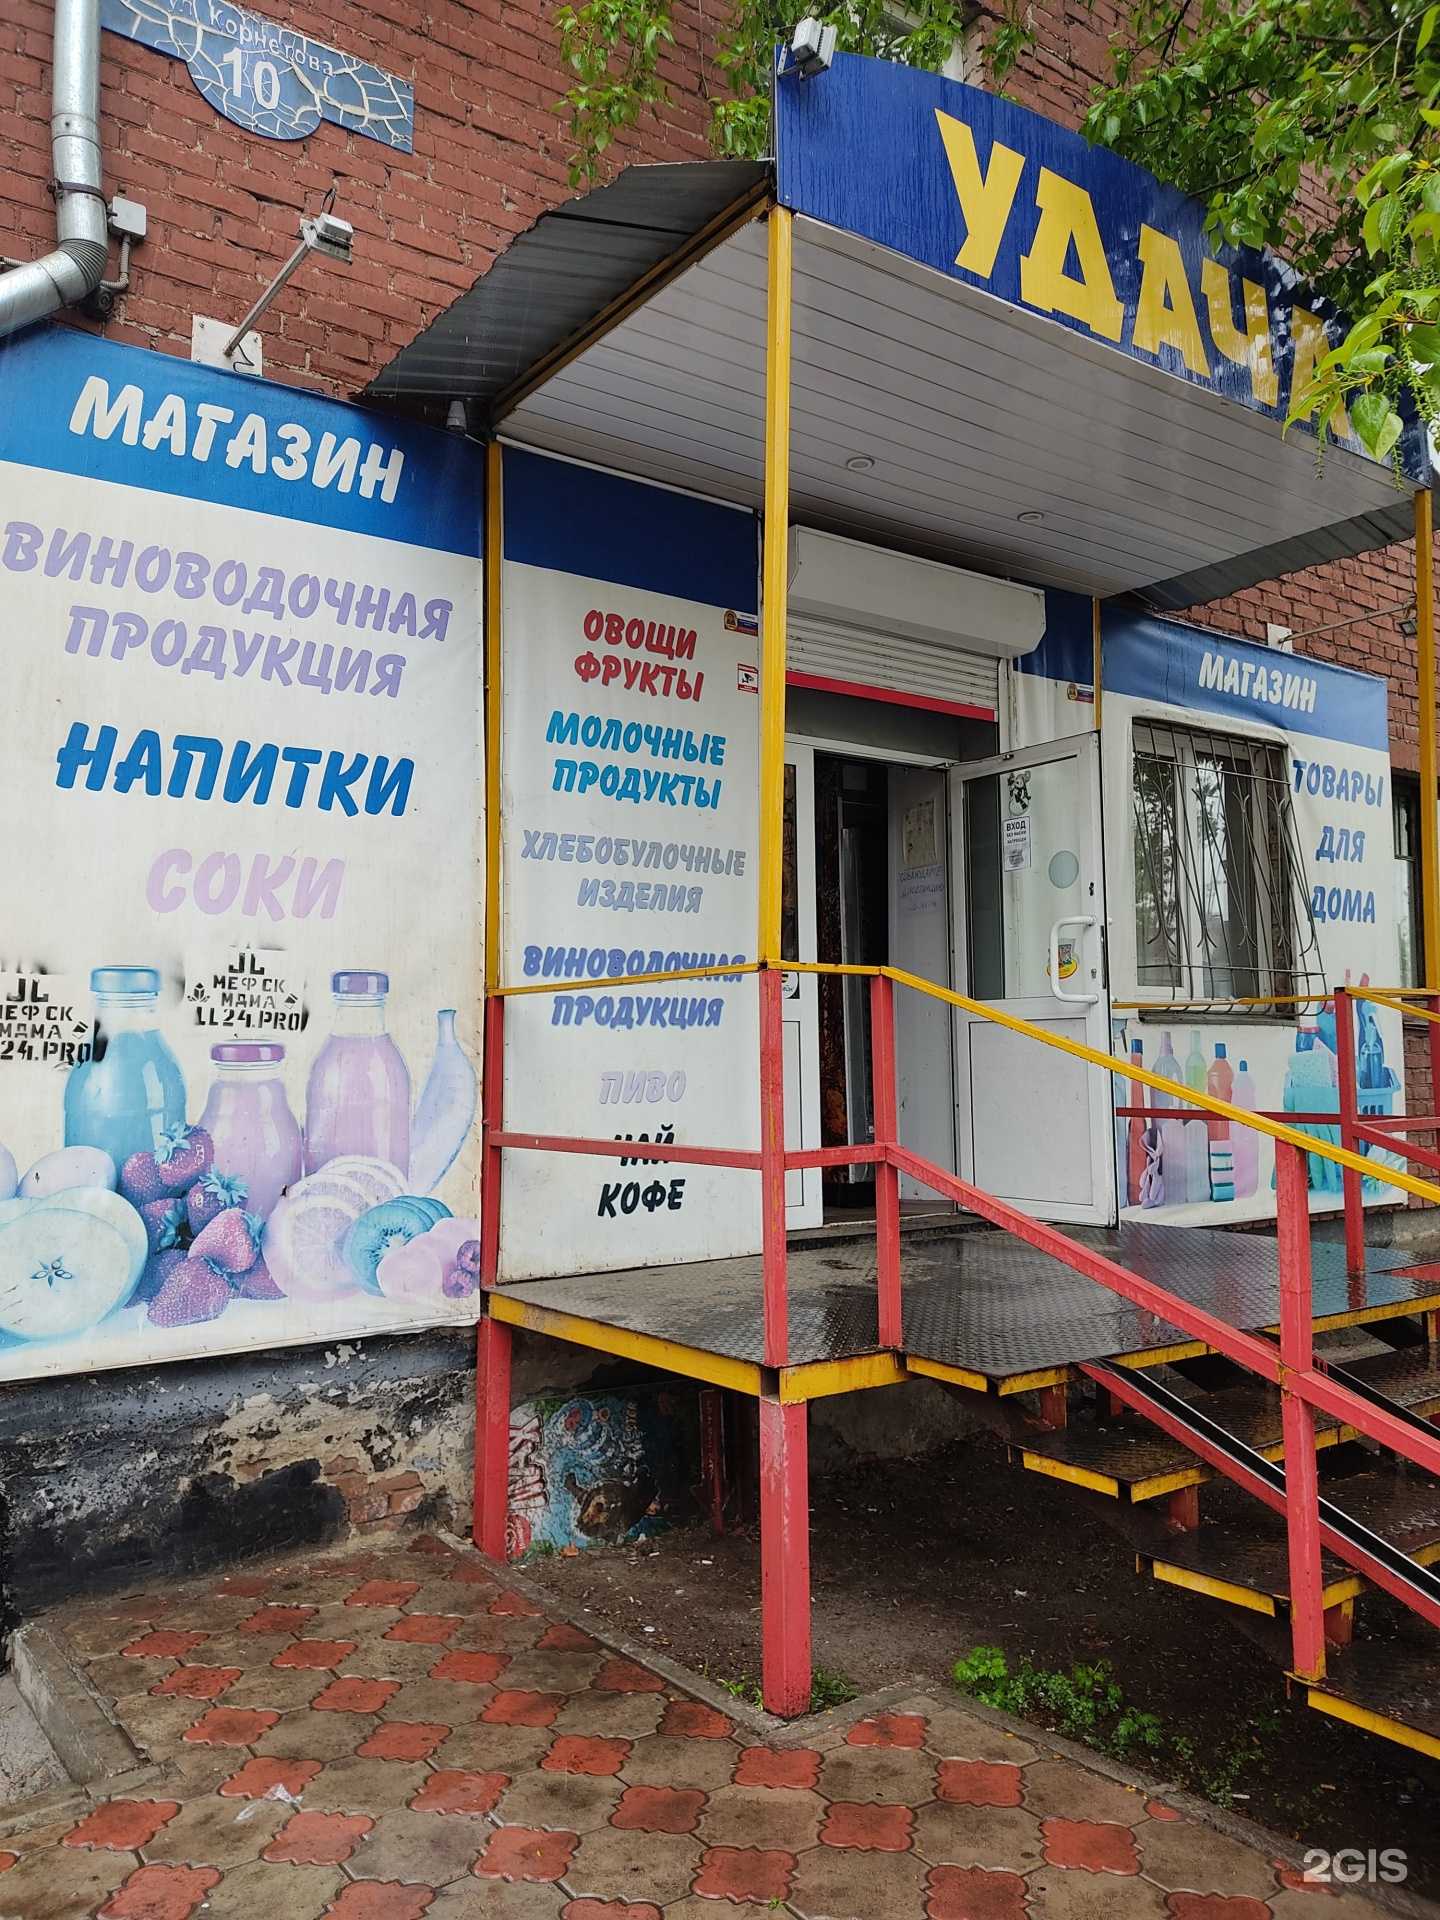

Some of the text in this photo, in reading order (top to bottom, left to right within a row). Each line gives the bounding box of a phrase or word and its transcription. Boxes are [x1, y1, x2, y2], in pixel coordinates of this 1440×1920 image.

[223, 47, 281, 110] 10
[933, 107, 1351, 441] УДАЧА
[69, 375, 405, 504] МАГАЗИН
[1, 521, 454, 642] ВИНОВОДОЧНАЯ
[64, 605, 407, 698] ПРОДУКЦИЯ
[583, 609, 698, 661] ОВОЩИ
[574, 650, 704, 702] ФРУКТЫ
[1198, 652, 1318, 714] МАГАЗИН
[545, 710, 727, 766] МОЛОЧНЫЕ
[56, 721, 415, 817] НАПИТКИ
[551, 758, 722, 809] ПРОДУКТЫ
[1292, 759, 1384, 808] ТОВАРЫ
[1006, 820, 1026, 832] ВХОД
[1315, 825, 1366, 864] ДЛЯ
[520, 829, 747, 876] ХЛЕБОБУЛОЧНЫЕ
[145, 848, 347, 922] СОКИ
[576, 878, 704, 913] ИЗДЕЛИЯ
[1311, 885, 1376, 924] ДОМА
[0, 1004, 40, 1021] ЕФ
[551, 995, 725, 1030] ПРОДУКЦИЯ
[599, 1070, 687, 1105] ПИВО
[597, 1178, 686, 1218] КОФЕ
